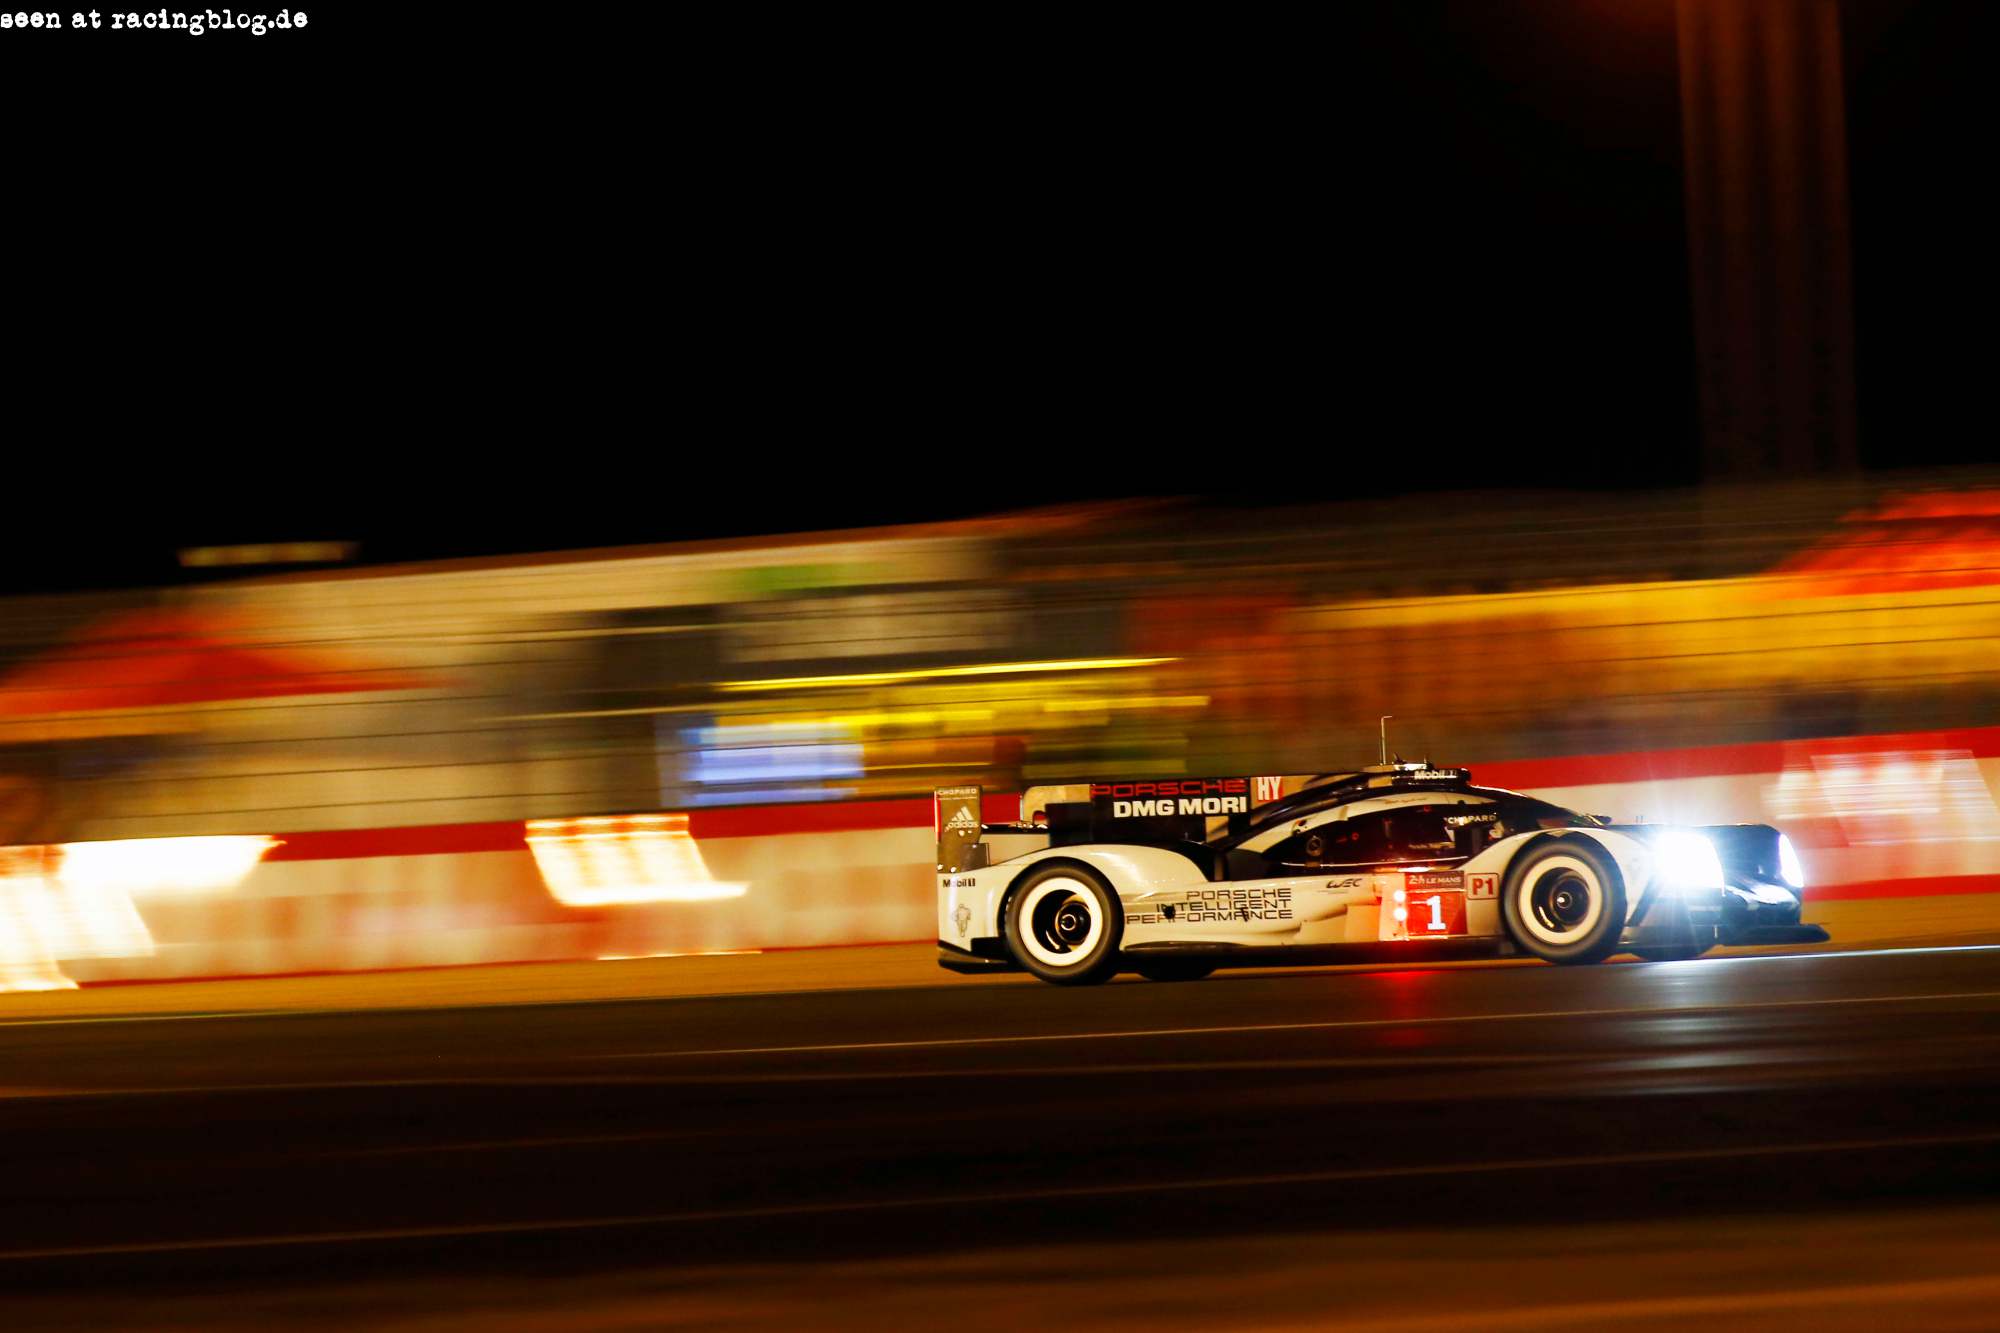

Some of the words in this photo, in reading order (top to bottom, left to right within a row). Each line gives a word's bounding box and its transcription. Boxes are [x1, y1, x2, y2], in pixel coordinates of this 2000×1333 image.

[1414, 770, 1445, 780] Mobil
[1090, 778, 1248, 798] PORSCHE
[1257, 776, 1282, 801] HY
[1113, 799, 1175, 818] DMG
[1179, 796, 1247, 815] MORI
[947, 820, 979, 830] adidas
[1448, 814, 1497, 825] CHPARD
[943, 878, 967, 888] Mbil
[1472, 877, 1494, 896] P1
[1186, 888, 1292, 900] PORSCHE
[1156, 899, 1292, 912] INTELLIGENT
[1426, 895, 1447, 930] 1
